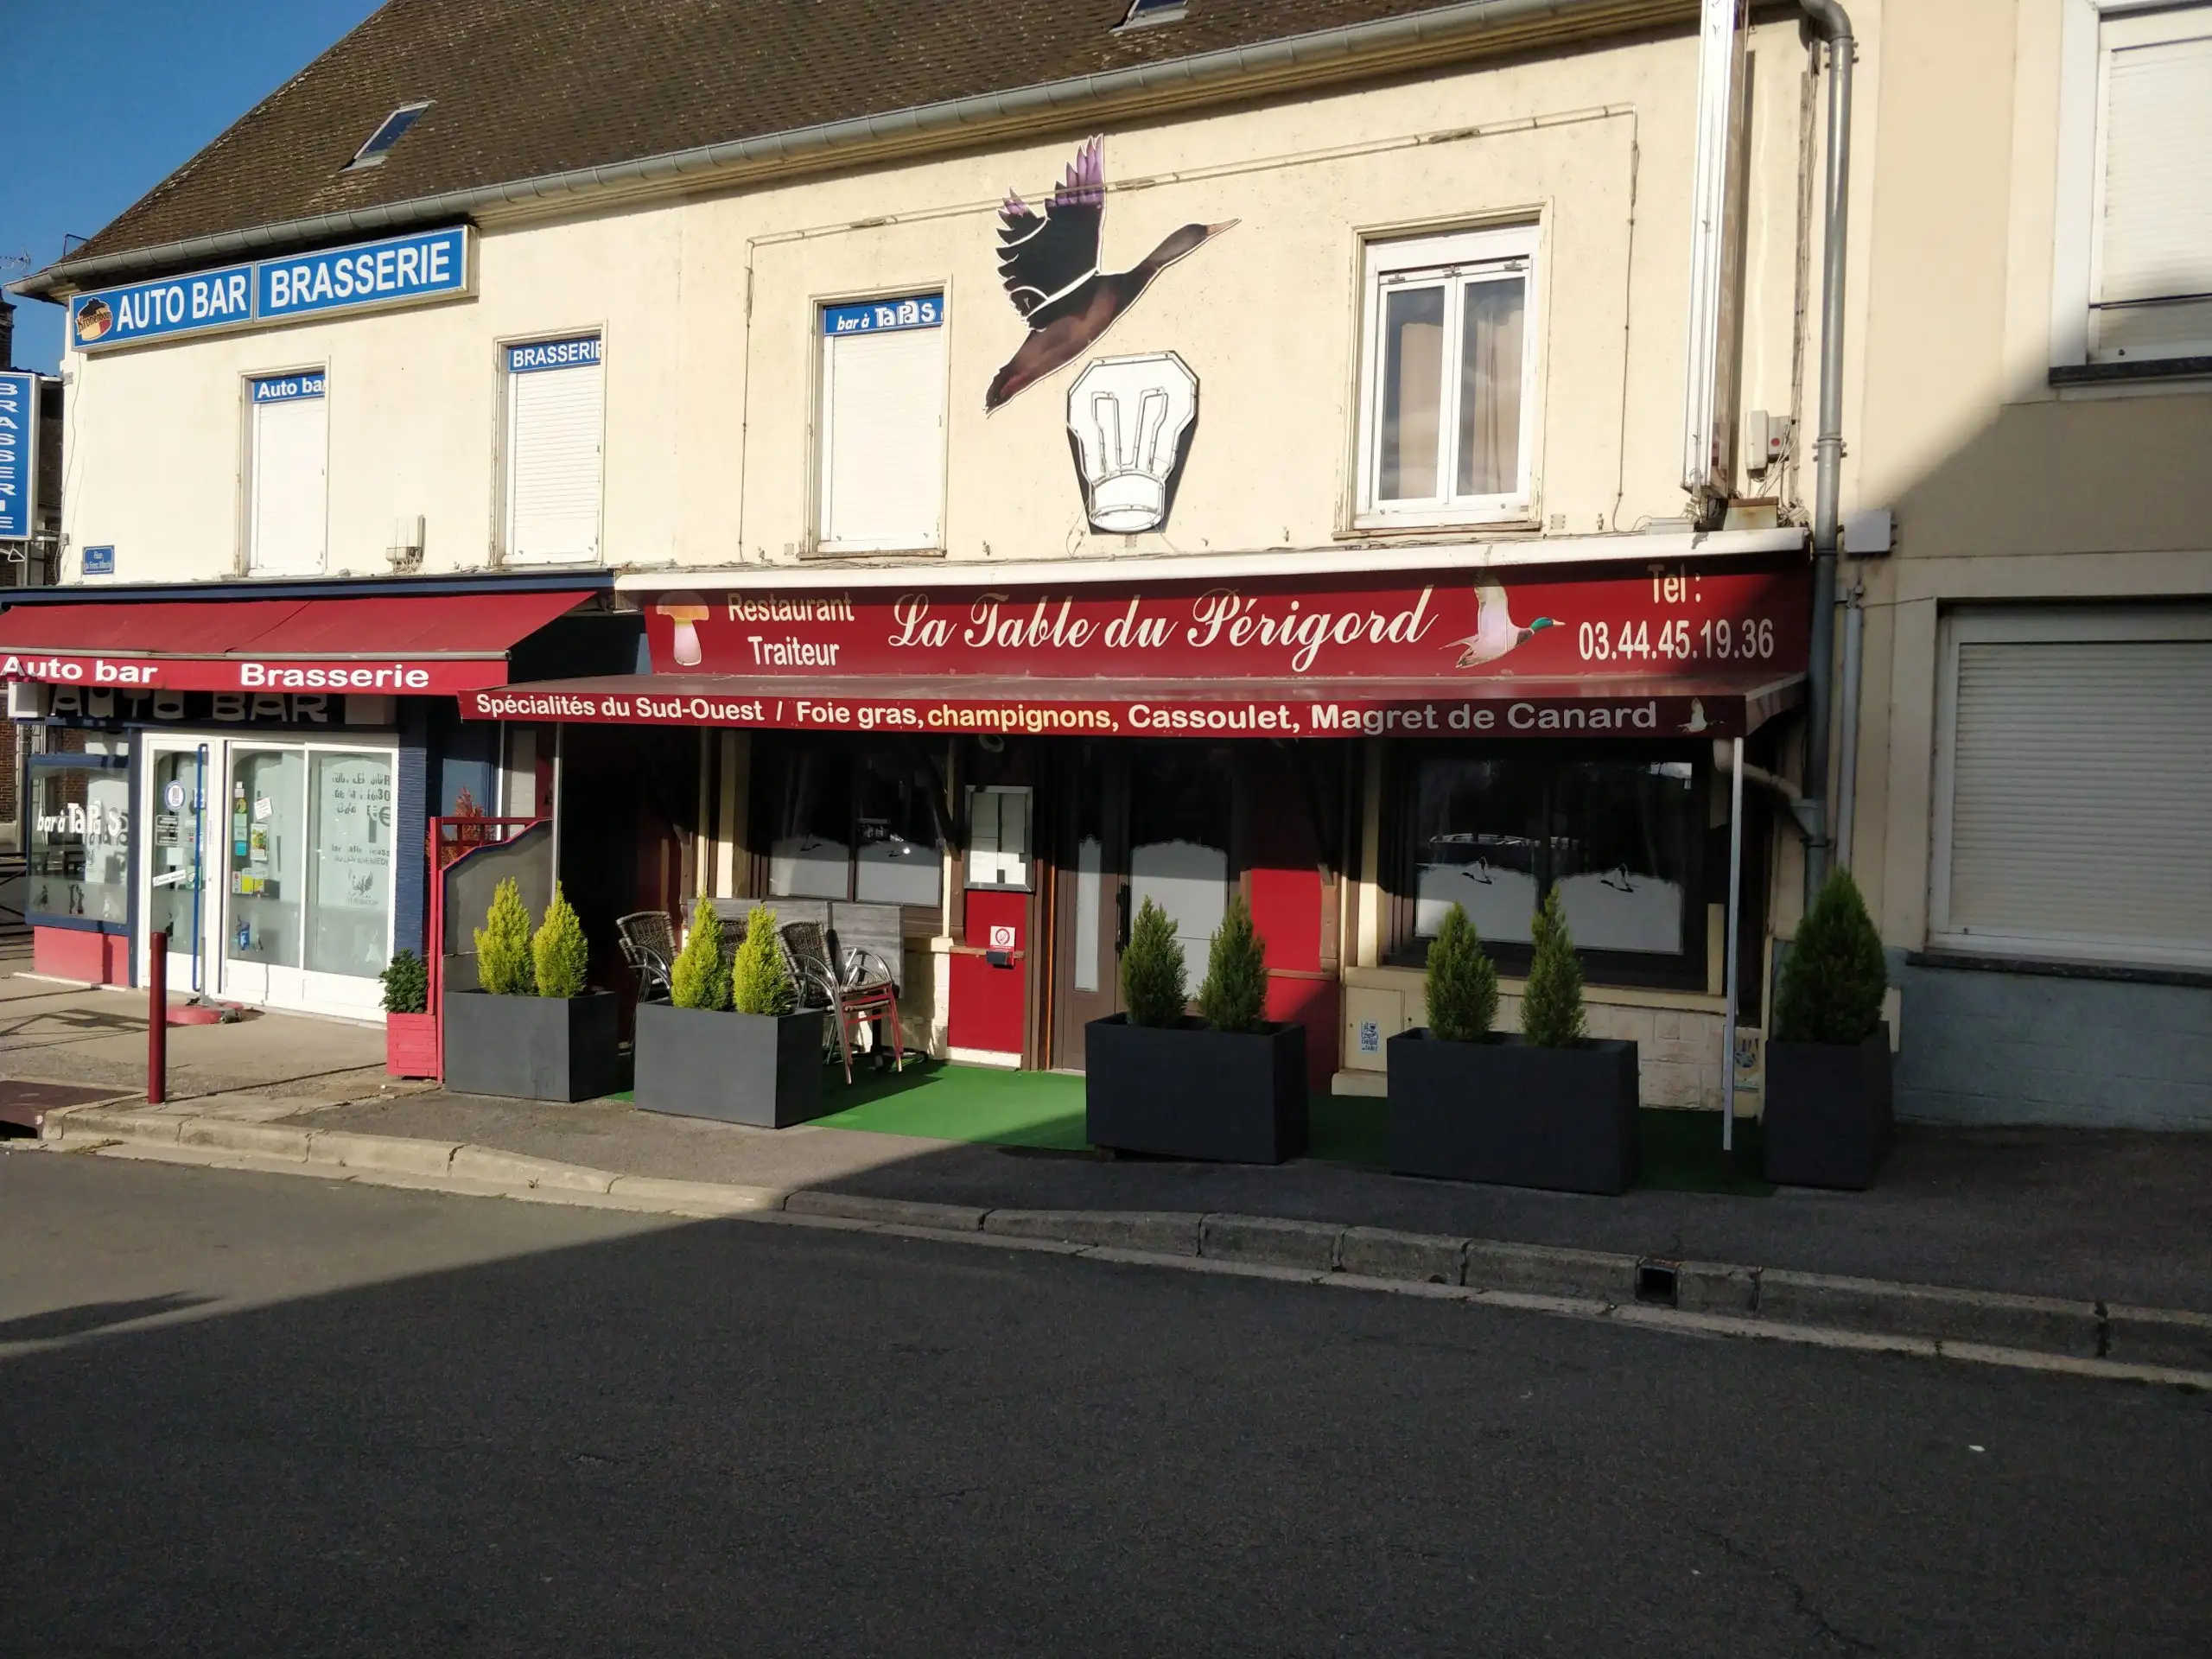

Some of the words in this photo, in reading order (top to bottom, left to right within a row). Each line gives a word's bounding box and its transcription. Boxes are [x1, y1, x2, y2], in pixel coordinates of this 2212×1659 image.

[270, 241, 450, 308] BRASSERIE
[117, 286, 185, 332] AUTO
[192, 275, 247, 320] BAR
[836, 315, 860, 331] bar
[861, 312, 870, 328] à
[257, 380, 298, 398] Auto
[1647, 563, 1686, 603] Tel
[727, 591, 855, 621] Restaurant
[888, 594, 957, 647] La
[963, 593, 1100, 647] Table
[1104, 594, 1179, 647] du
[1187, 584, 1439, 672] Périgord
[1579, 618, 1774, 661] 03.44.45.19.36
[747, 636, 840, 665] Traiteur
[0, 656, 83, 680] Auto
[95, 659, 159, 683] bar
[240, 663, 429, 688] Brasserie
[476, 694, 596, 718] Spécialités
[601, 696, 631, 717] du
[636, 696, 766, 721] Sud-Ouest
[797, 702, 850, 723] Foie
[857, 705, 925, 729] gras,
[927, 704, 1119, 733] champignons,
[1128, 704, 1300, 734] Cassoulet,
[1312, 704, 1440, 735] Magret
[1447, 703, 1495, 729] de
[1507, 701, 1657, 729] Canard
[37, 807, 56, 832] bar
